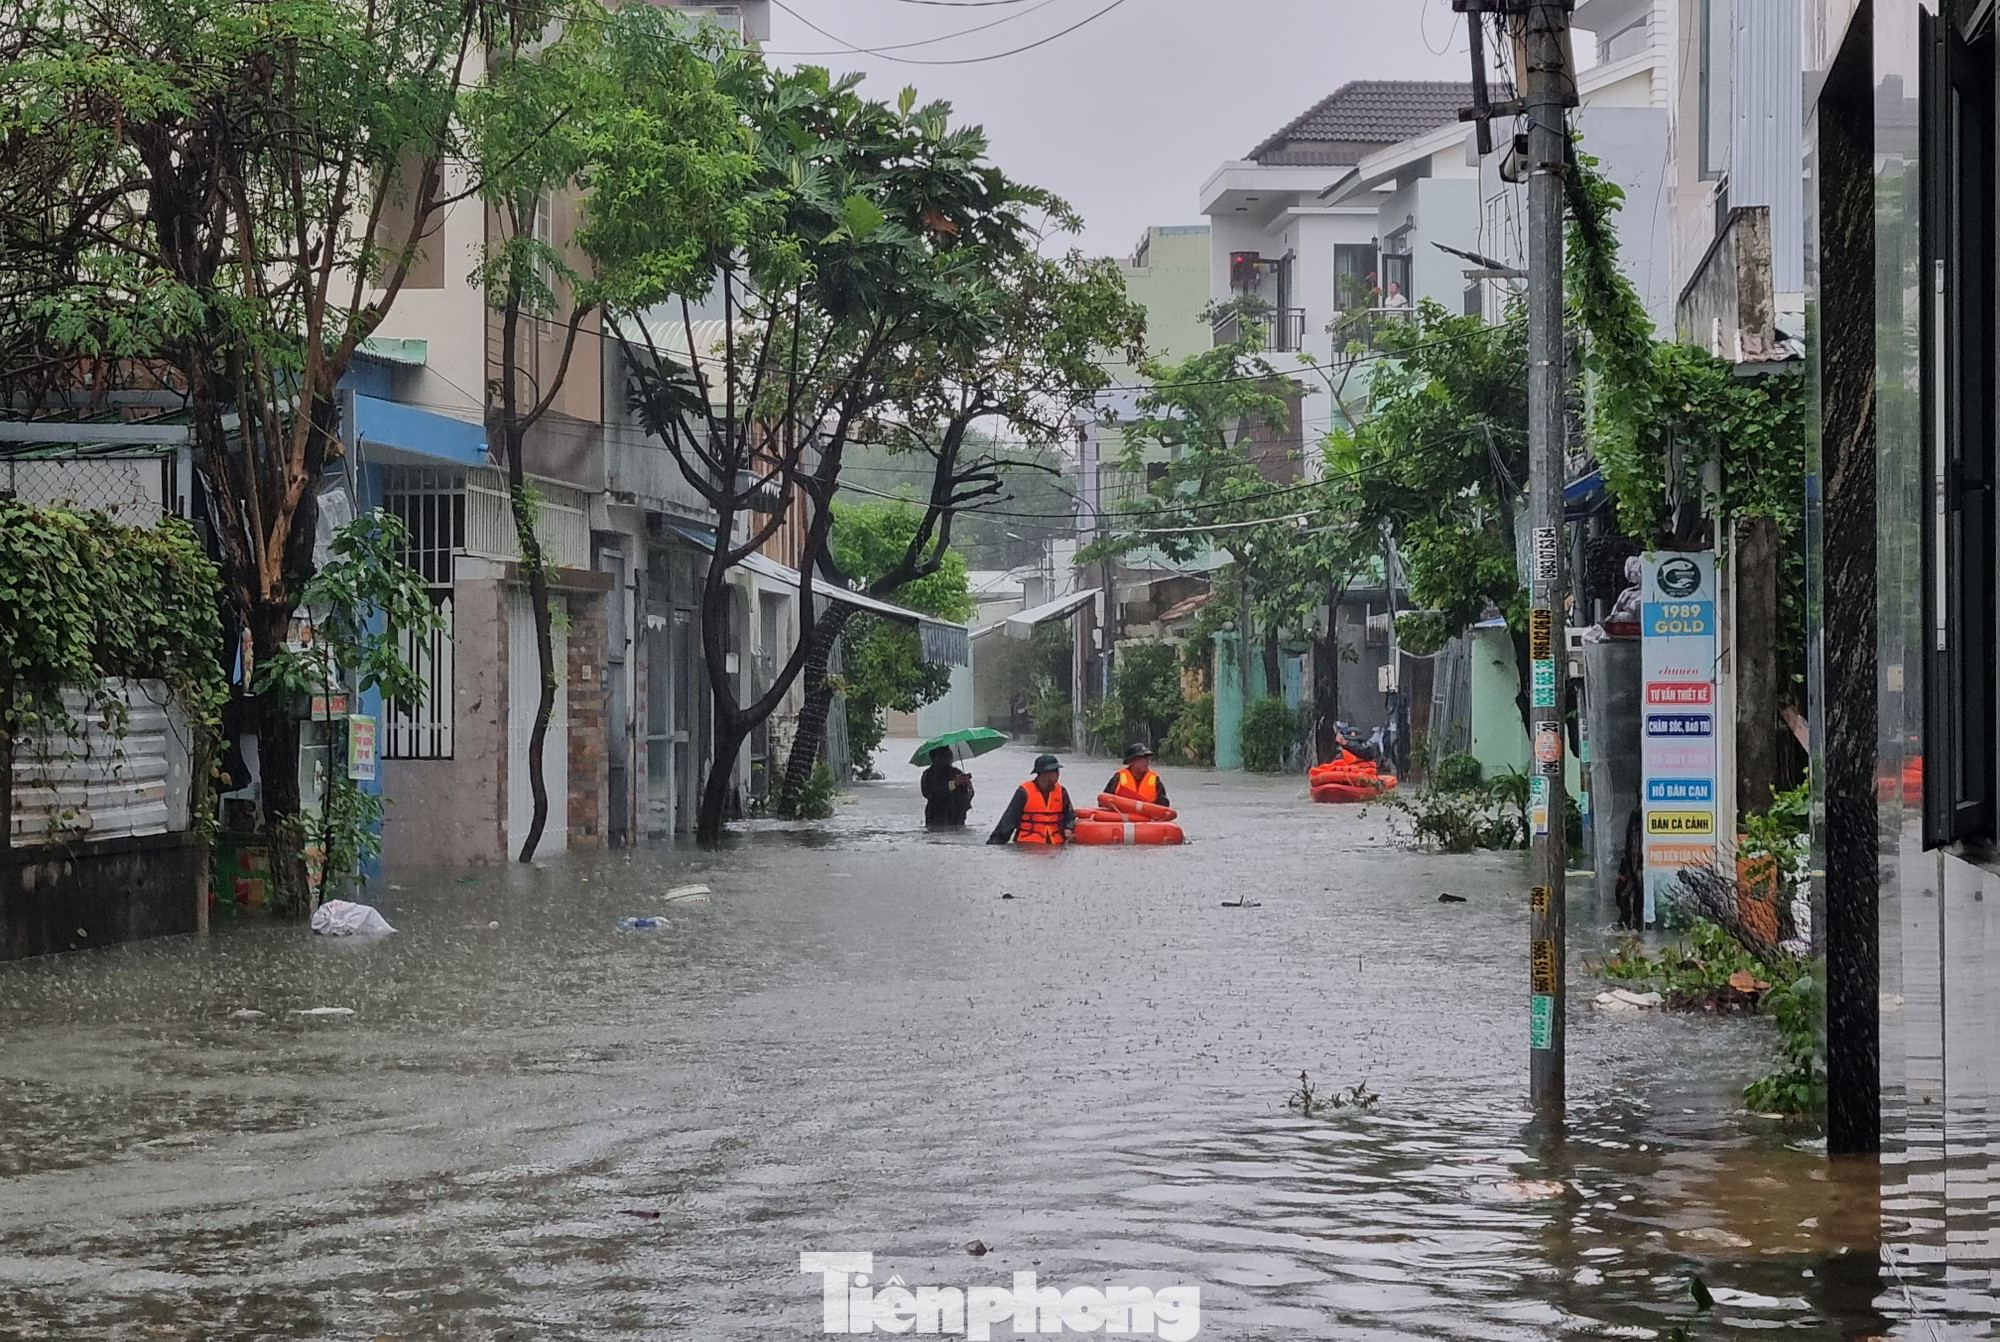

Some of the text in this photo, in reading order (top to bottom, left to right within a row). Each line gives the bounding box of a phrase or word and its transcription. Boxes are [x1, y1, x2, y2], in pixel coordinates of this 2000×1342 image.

[1661, 604, 1701, 618] 1989
[1655, 620, 1705, 634] GOLD
[1661, 686, 1676, 701] VẤN
[1677, 686, 1696, 701] THIẾT
[1698, 686, 1708, 701] KẾ
[1649, 719, 1668, 732] CHĂM
[1685, 717, 1699, 732] BẢO
[1667, 784, 1686, 797] BÁN
[1688, 785, 1708, 800] CẠN
[1651, 816, 1708, 829] BÁN CÁ CẢNH
